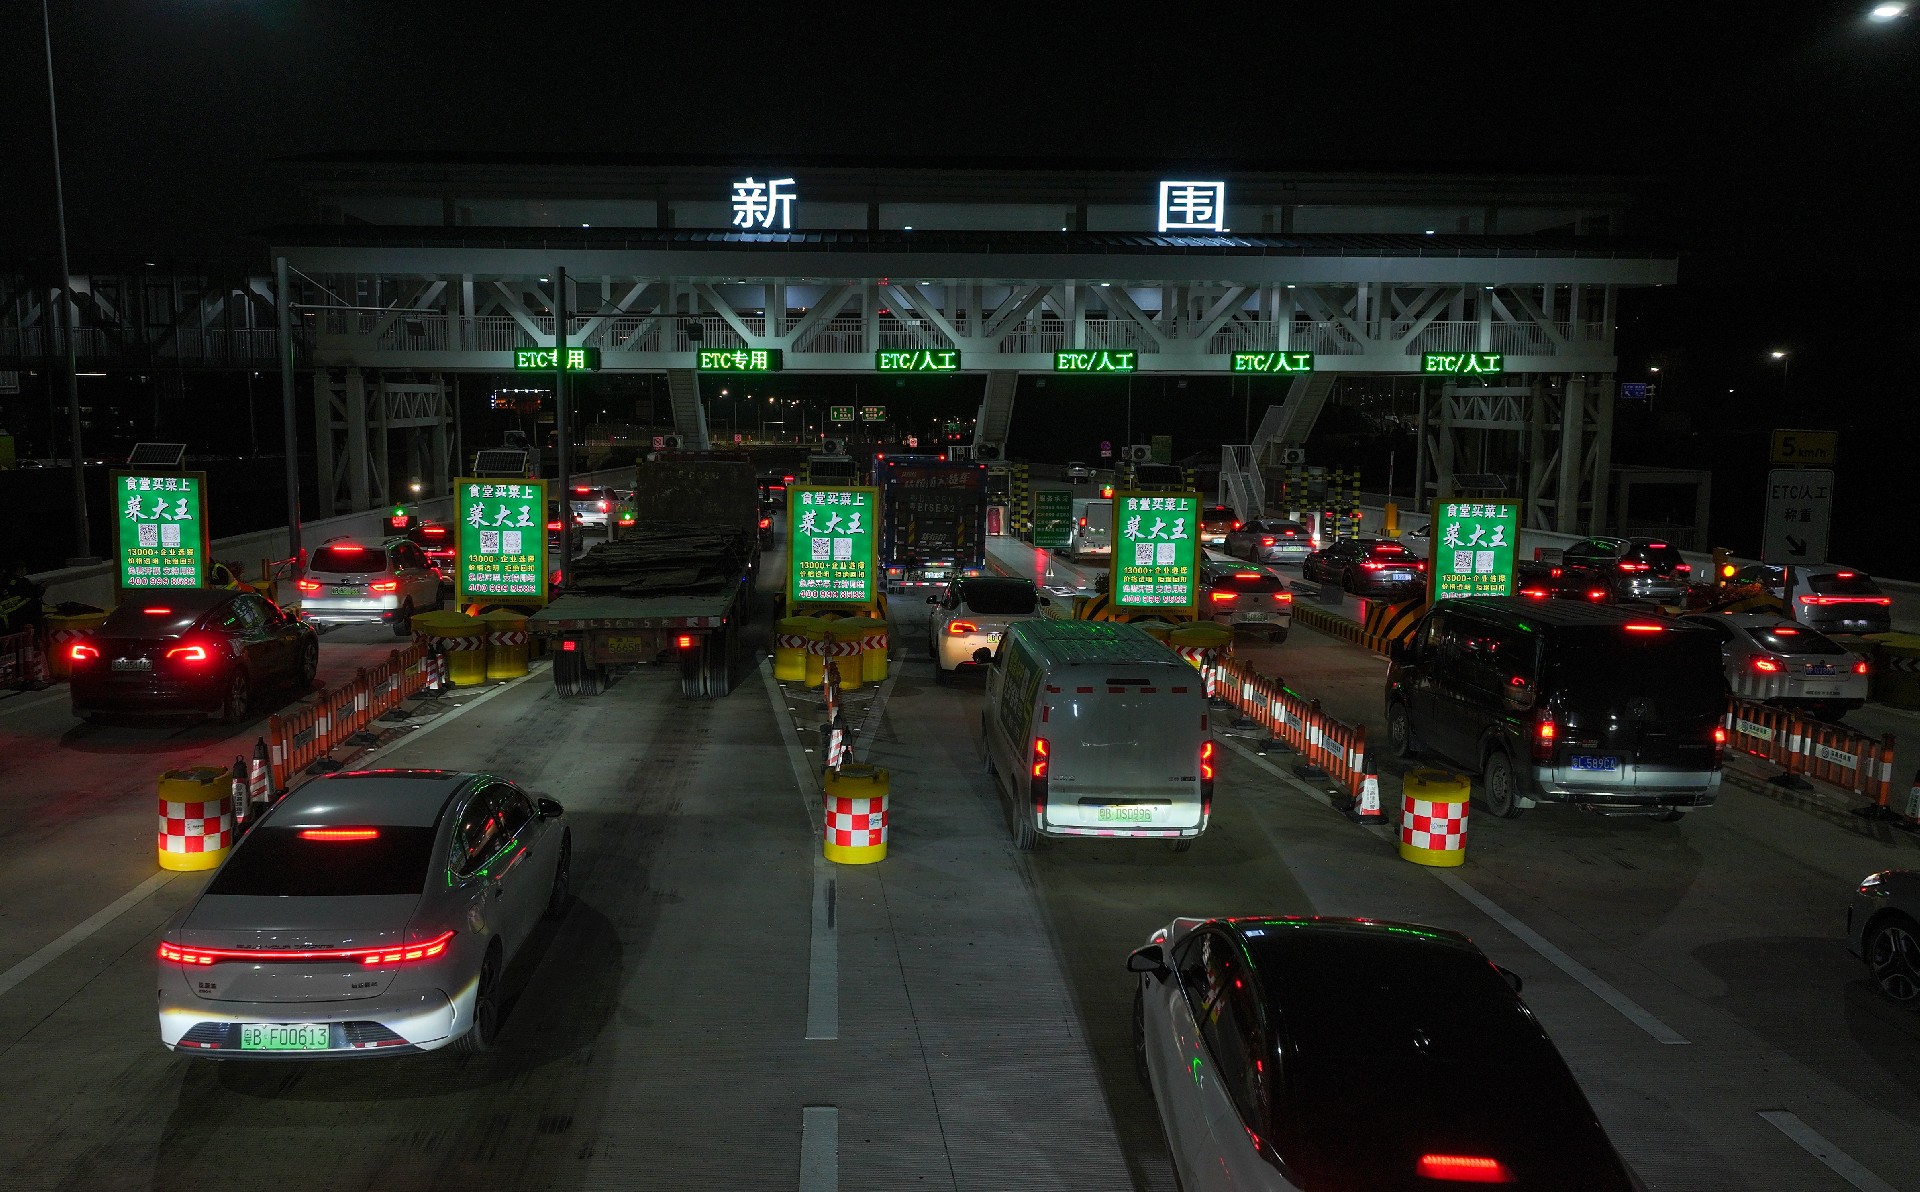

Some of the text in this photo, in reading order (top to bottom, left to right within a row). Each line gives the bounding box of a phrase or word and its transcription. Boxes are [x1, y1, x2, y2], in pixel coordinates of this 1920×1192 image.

[731, 177, 1225, 232] 新 围
[701, 350, 768, 369] ETC专用
[881, 351, 956, 370] ETC/人工
[1058, 351, 1134, 370] ETC/人工
[1235, 353, 1311, 372] ETC/人工
[1426, 354, 1500, 373] ETC/人工
[1782, 437, 1827, 458] 5 km/h
[126, 477, 190, 492] 食堂买菜上
[468, 484, 534, 499] 食堂买菜上
[1772, 485, 1828, 500] ETC/人工
[124, 494, 194, 523] 菜大王
[801, 492, 864, 506] 食堂买菜上
[1127, 498, 1188, 511] 食堂买菜上
[466, 501, 535, 529] 菜大王
[1447, 504, 1508, 518] 食堂买菜上
[1784, 507, 1812, 522] 称重
[799, 509, 865, 537] 菜大王
[1123, 514, 1188, 542] 菜大王
[1443, 521, 1508, 549] 菜大王
